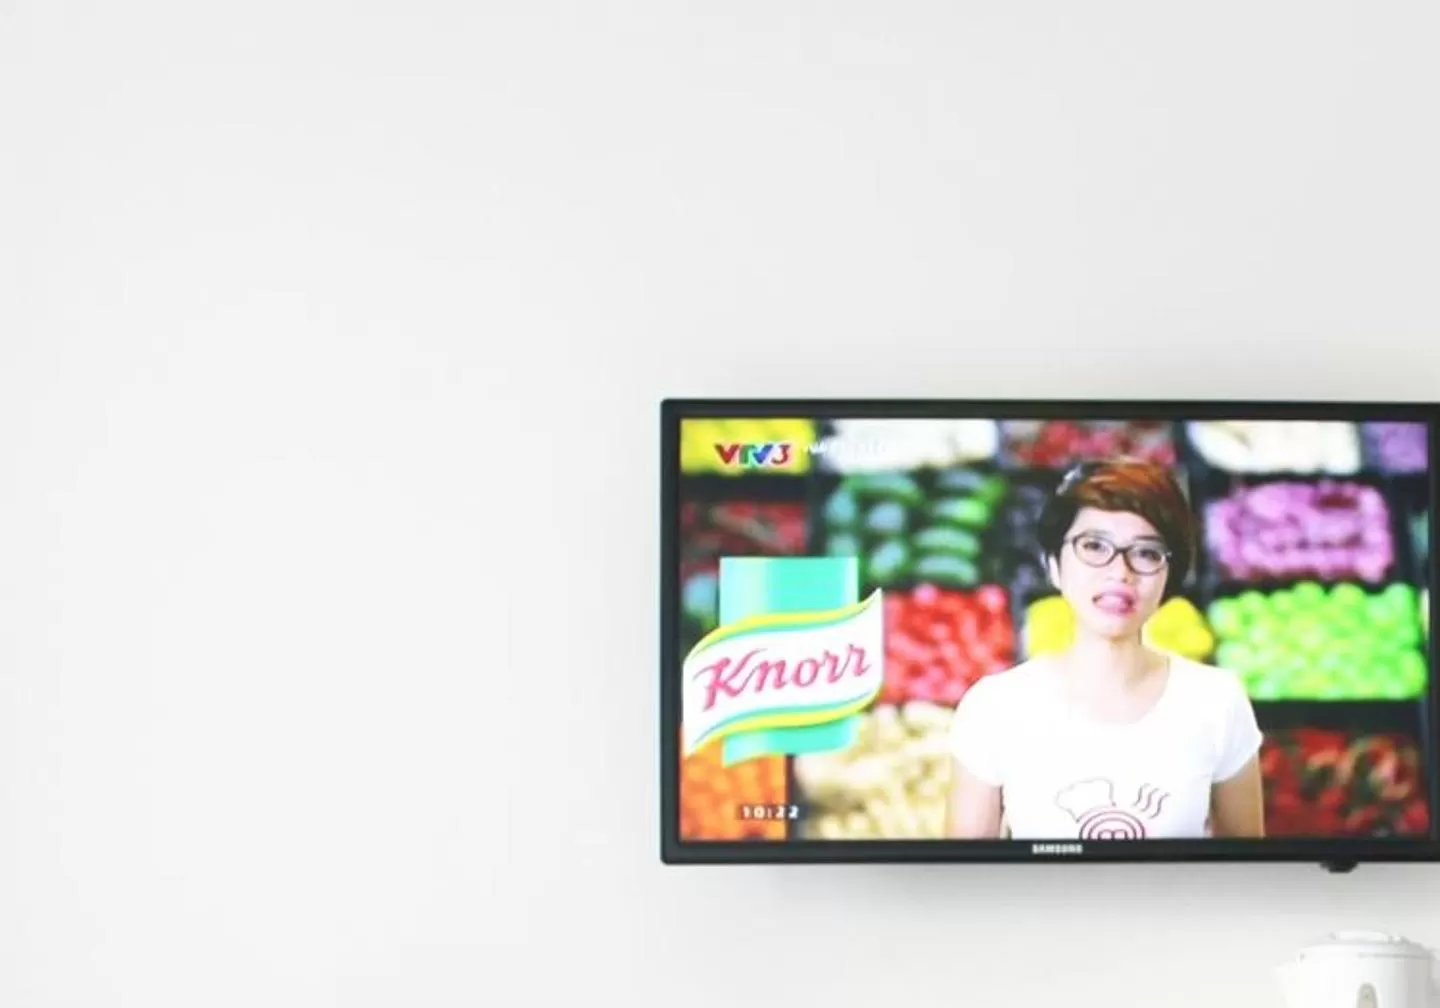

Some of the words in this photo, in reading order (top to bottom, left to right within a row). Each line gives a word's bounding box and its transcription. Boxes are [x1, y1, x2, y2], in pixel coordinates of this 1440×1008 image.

[714, 443, 791, 466] VTV3
[693, 643, 873, 711] Knorr
[743, 804, 799, 820] 10:22
